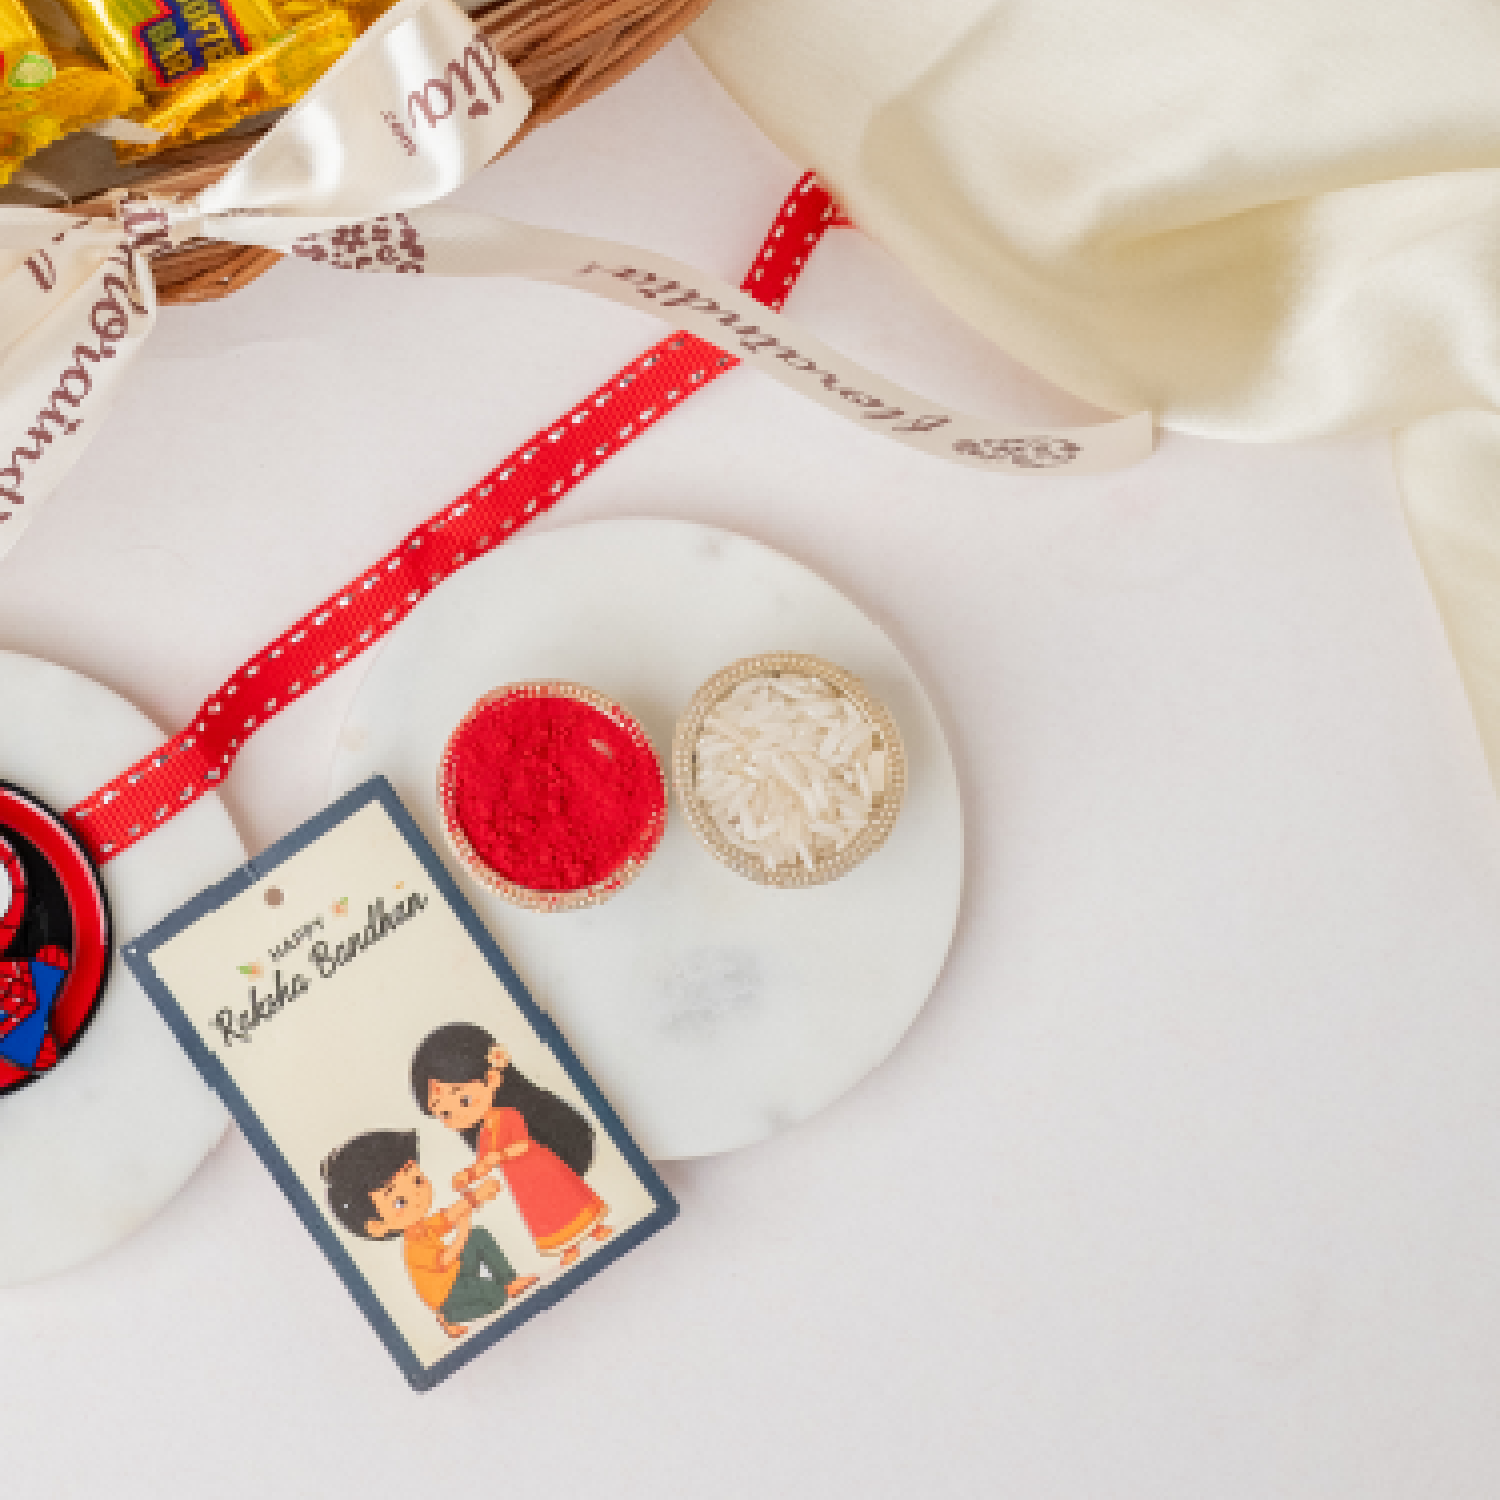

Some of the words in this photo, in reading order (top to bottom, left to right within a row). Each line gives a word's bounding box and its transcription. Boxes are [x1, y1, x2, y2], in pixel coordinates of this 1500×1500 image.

[149, 17, 189, 81] BAR
[214, 970, 311, 1046] Raksha
[309, 891, 428, 979] Bandhan
[268, 915, 325, 963] HAPPY
